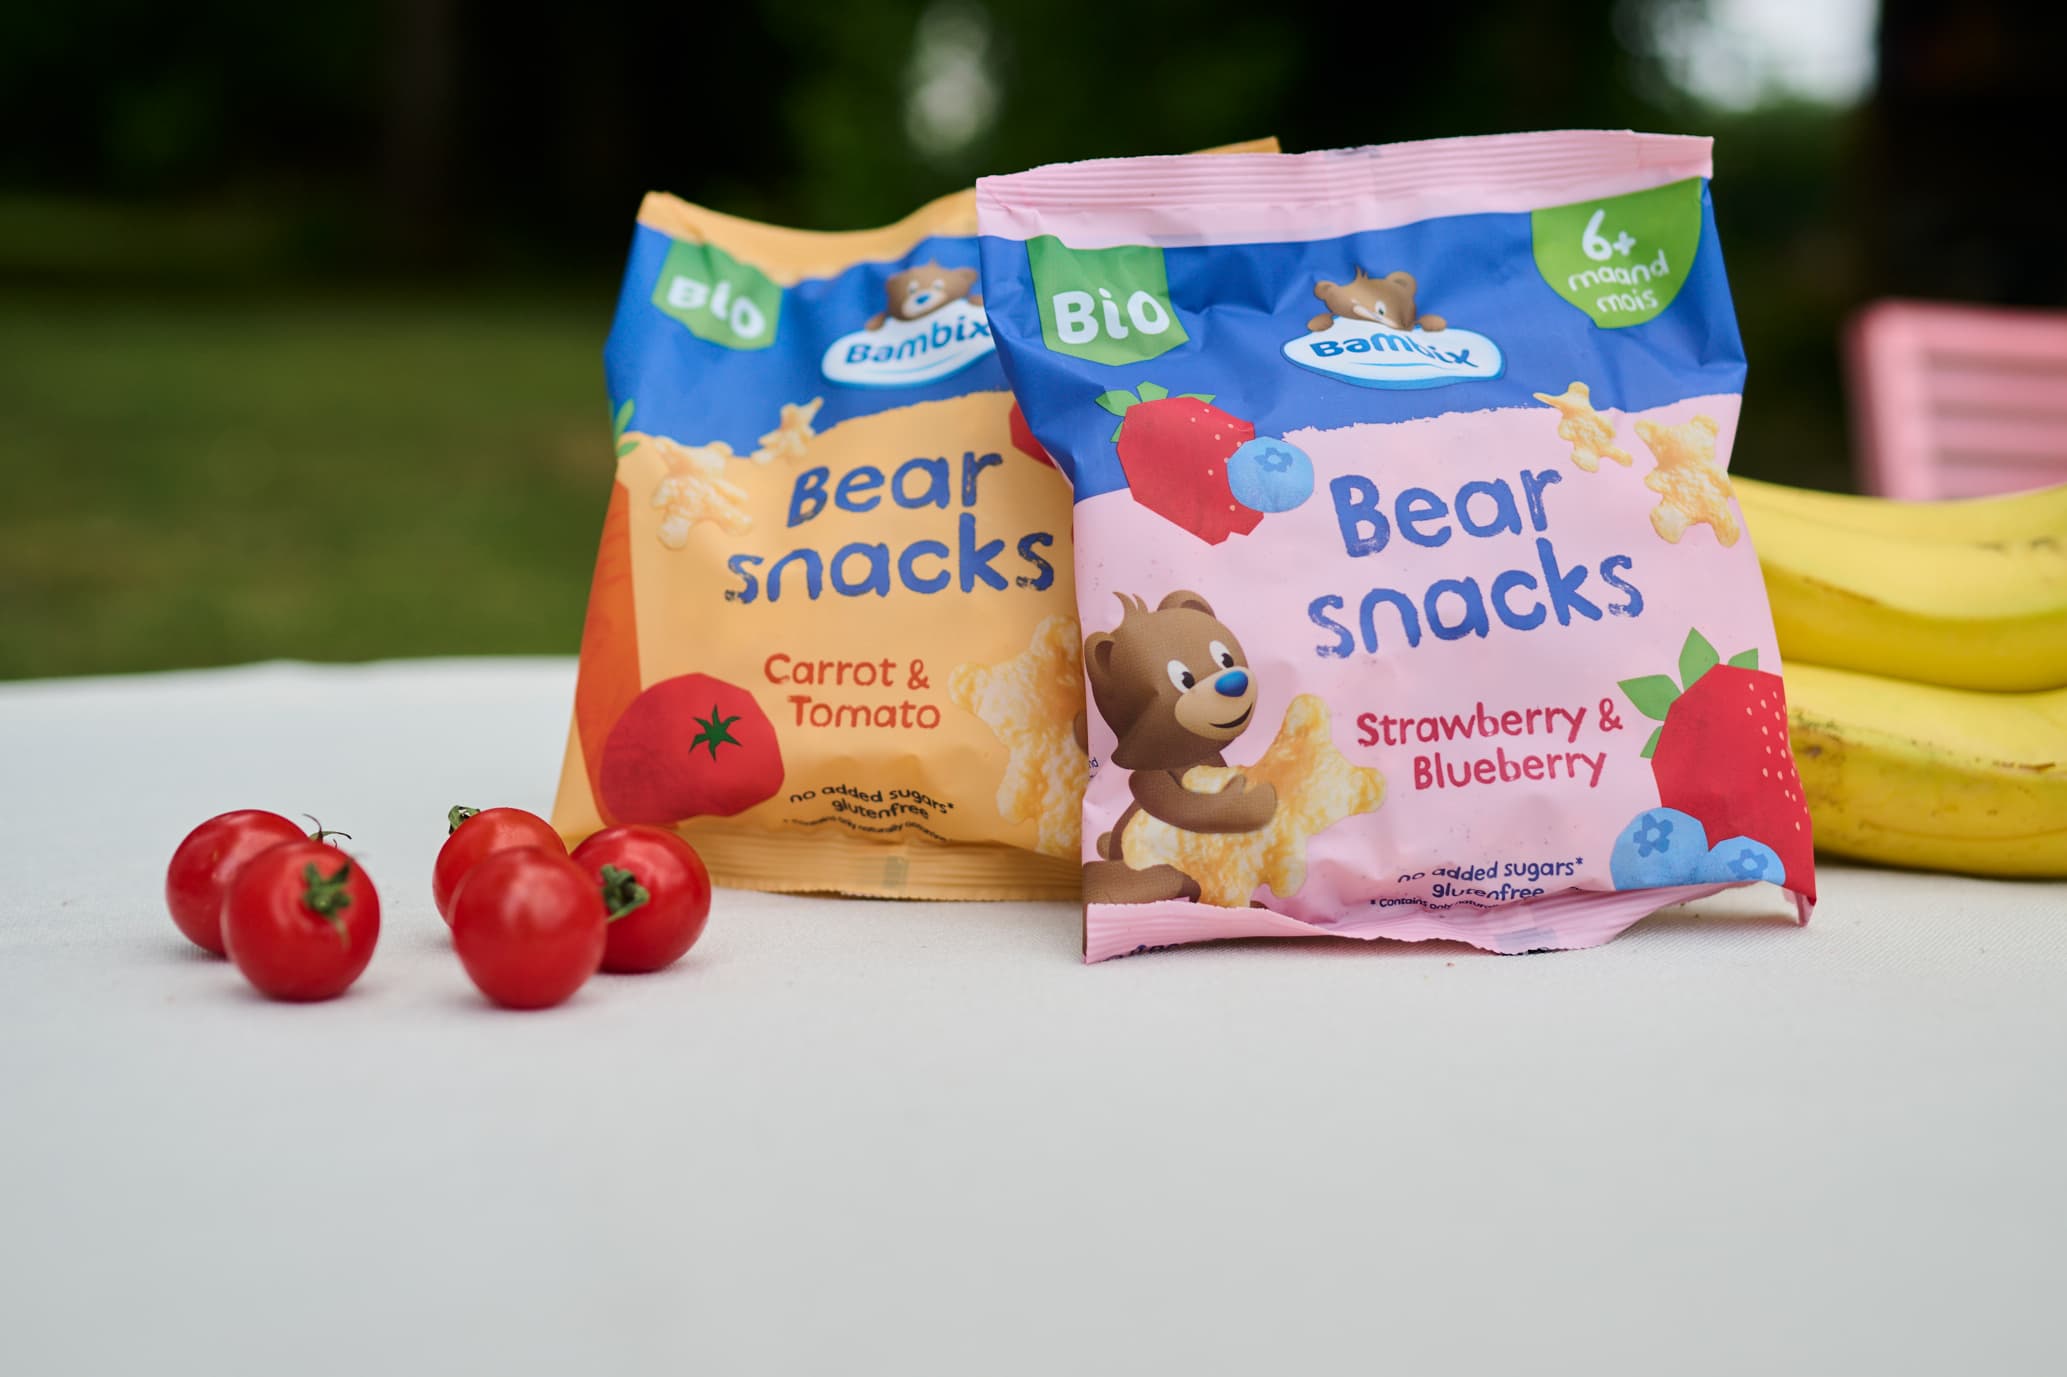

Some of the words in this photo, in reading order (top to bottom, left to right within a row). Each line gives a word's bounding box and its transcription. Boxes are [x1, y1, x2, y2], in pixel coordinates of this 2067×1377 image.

[1582, 209, 1637, 262] 6+
[1568, 248, 1670, 292] maand
[1596, 289, 1659, 313] mois
[845, 315, 991, 364] Bambix
[1309, 333, 1479, 368] Bambix
[786, 451, 1003, 528] Bear
[1329, 469, 1562, 558] Bear
[724, 512, 1054, 604] snacks
[1308, 537, 1644, 659] snacks
[764, 653, 897, 687] Carrot
[907, 659, 930, 690] &
[787, 695, 941, 729] Tomato
[1357, 702, 1587, 747] Strawberry
[1599, 698, 1623, 732] &
[1413, 747, 1607, 790] Blueberry
[789, 790, 816, 804] no
[821, 784, 883, 803] added
[832, 799, 929, 820] glutenfree
[1398, 872, 1425, 883] no
[1432, 861, 1498, 881] added
[1432, 883, 1545, 901] glutenfree
